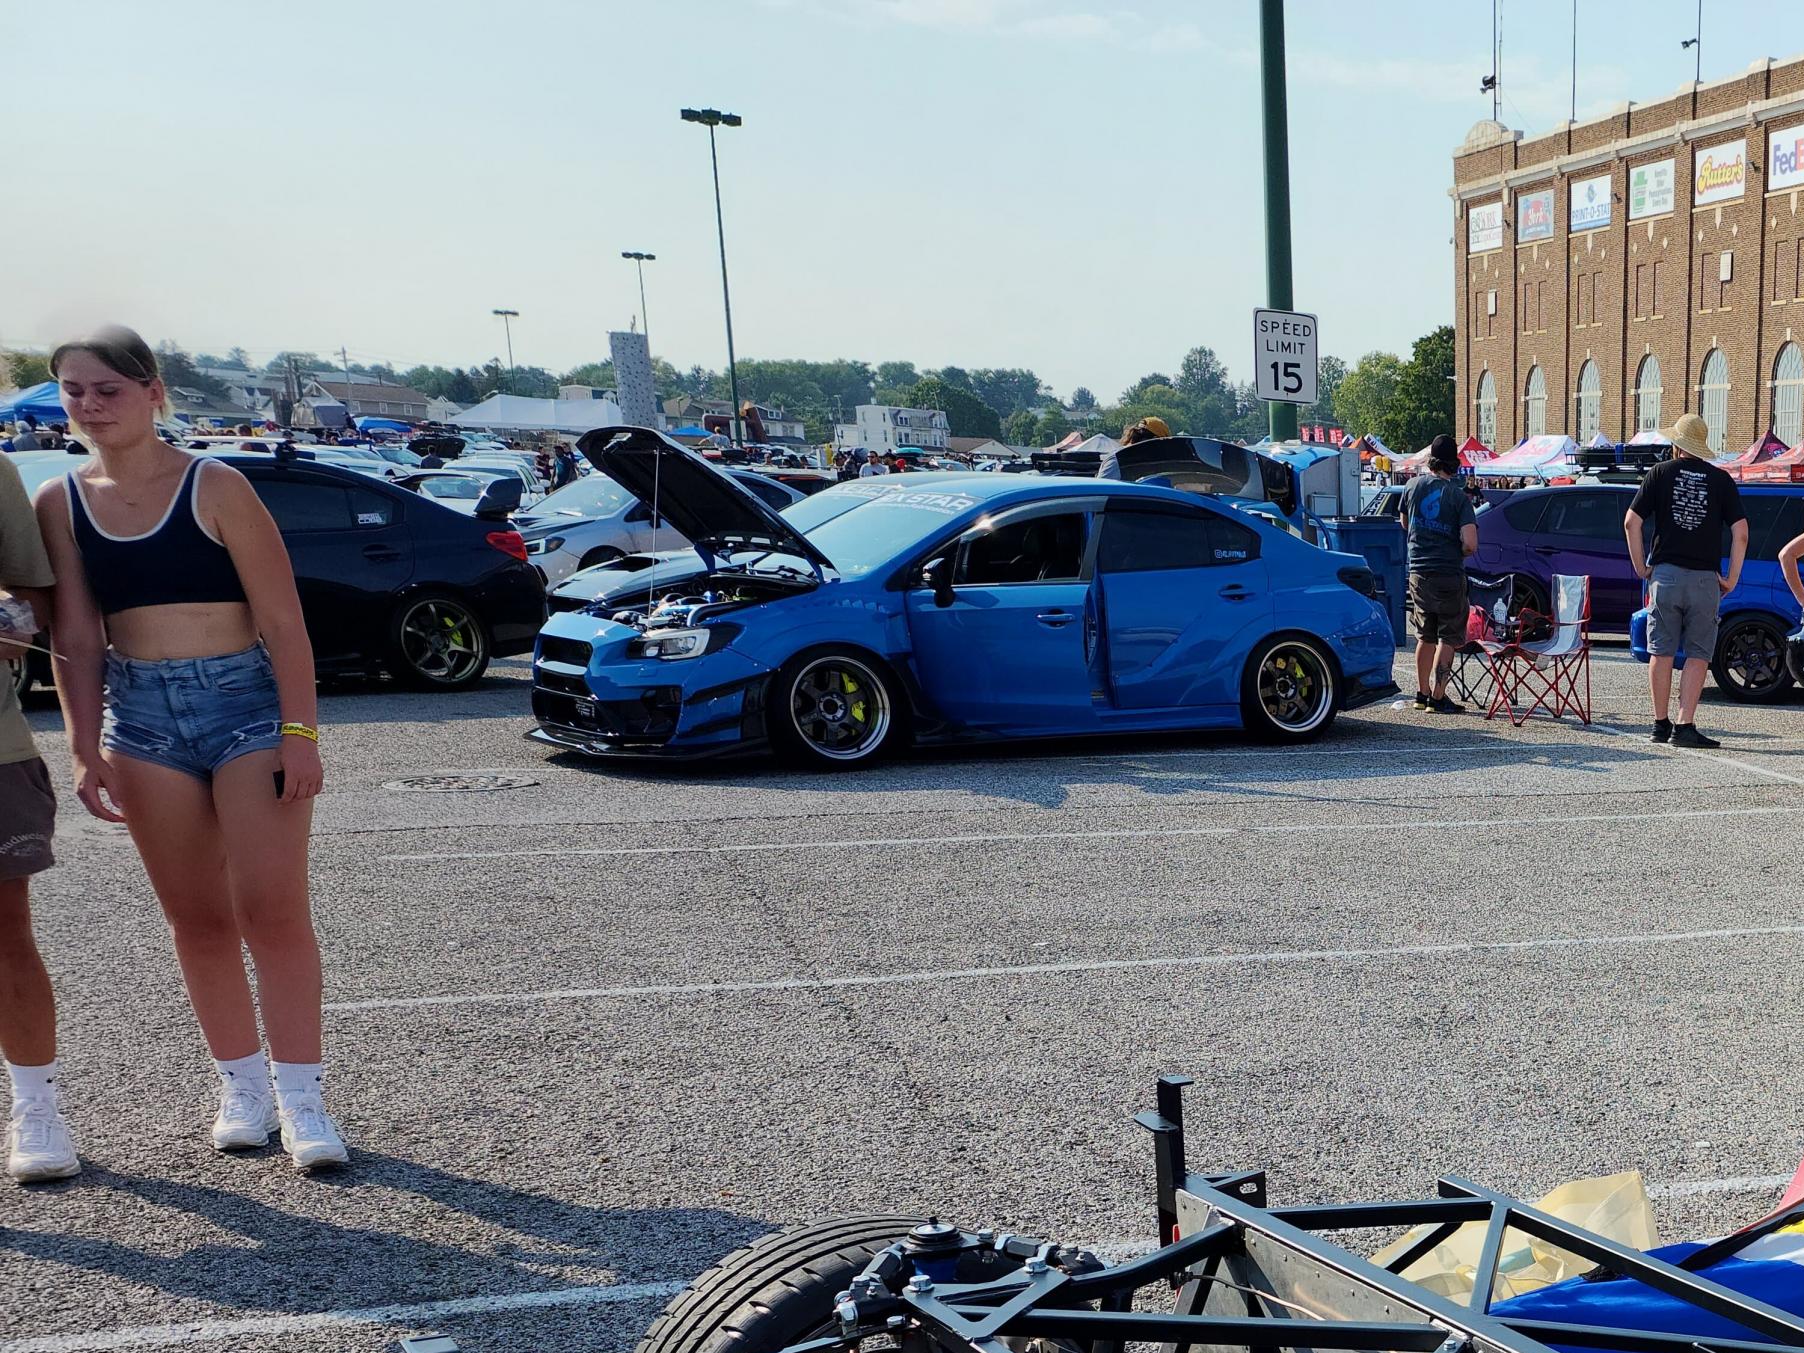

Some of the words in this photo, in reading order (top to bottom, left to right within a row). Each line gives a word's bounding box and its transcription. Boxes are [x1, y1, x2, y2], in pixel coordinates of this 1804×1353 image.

[1697, 154, 1744, 195] Rutter's
[1260, 320, 1312, 337] SPEED
[1266, 339, 1306, 355] LIMIT
[1270, 361, 1303, 394] 15
